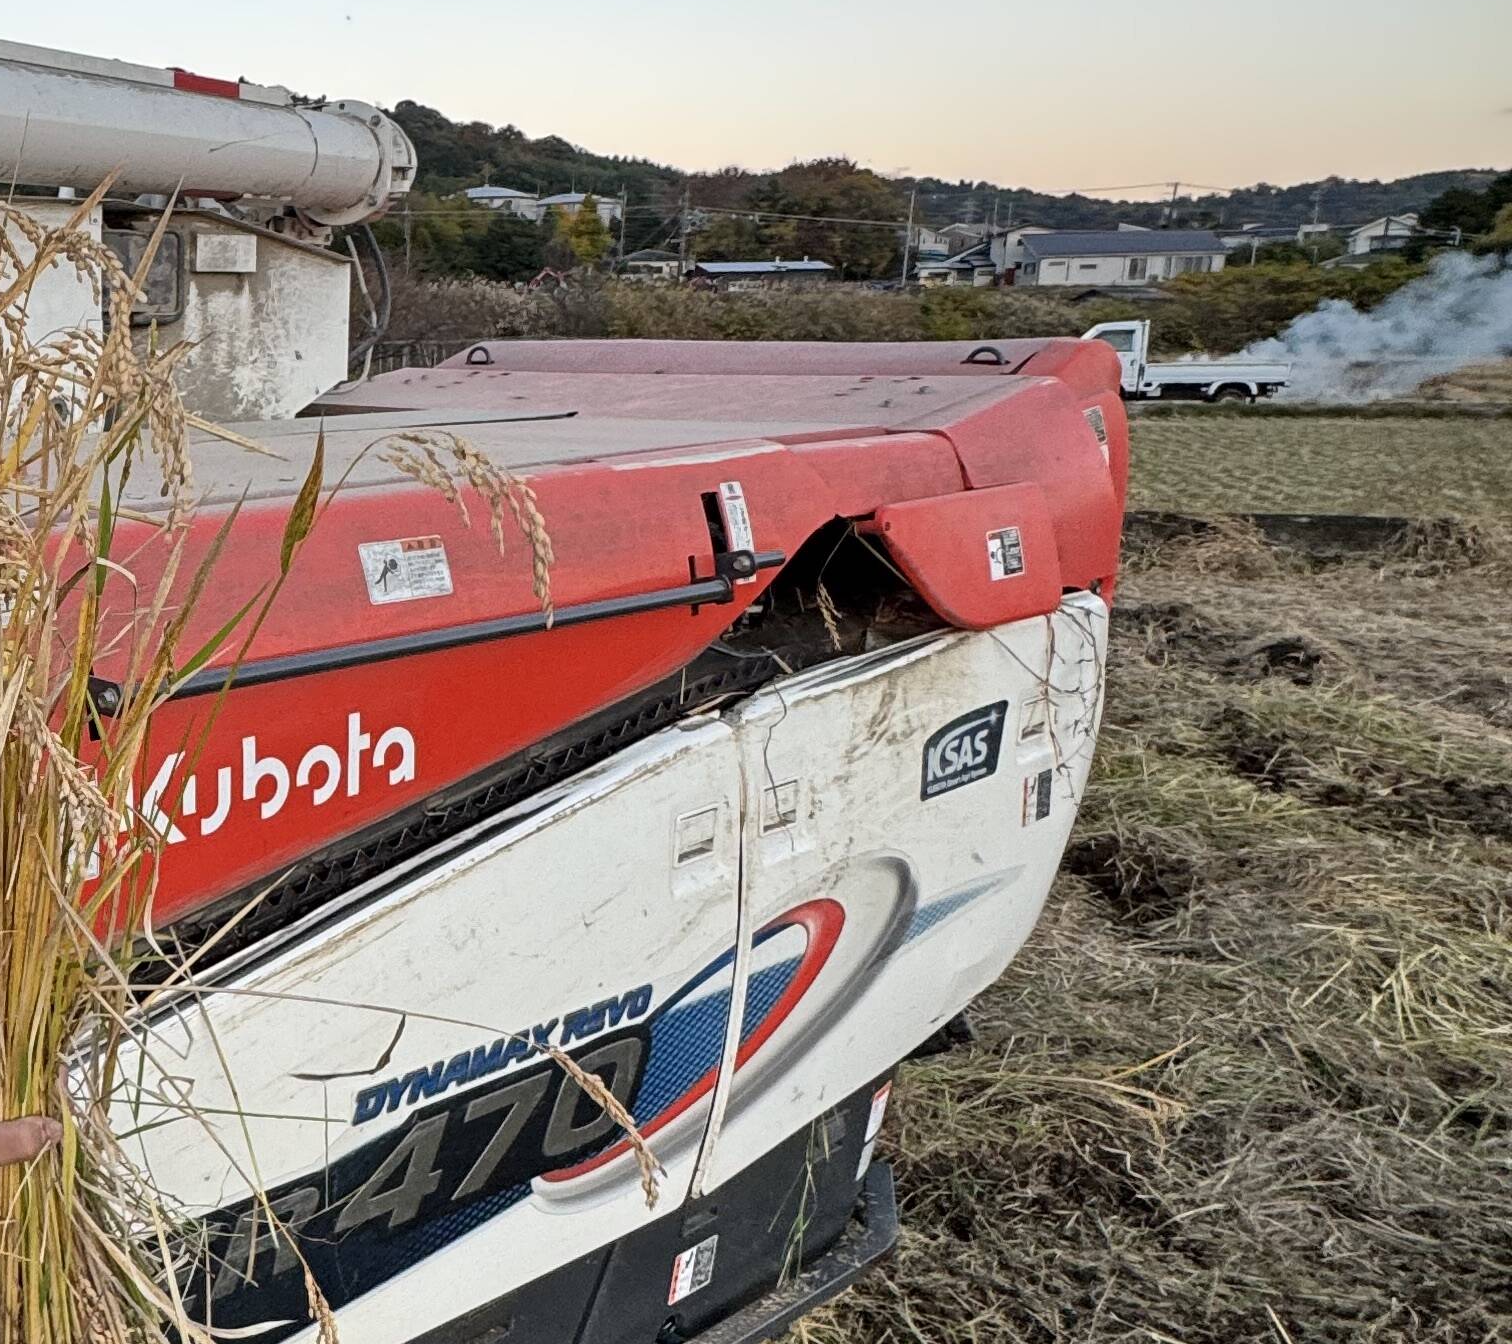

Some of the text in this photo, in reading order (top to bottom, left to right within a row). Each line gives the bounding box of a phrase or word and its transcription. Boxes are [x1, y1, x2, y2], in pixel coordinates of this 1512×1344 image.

[117, 712, 416, 844] Kubota
[927, 728, 989, 784] KSAS
[352, 983, 654, 1126] DYNAMAX REVO
